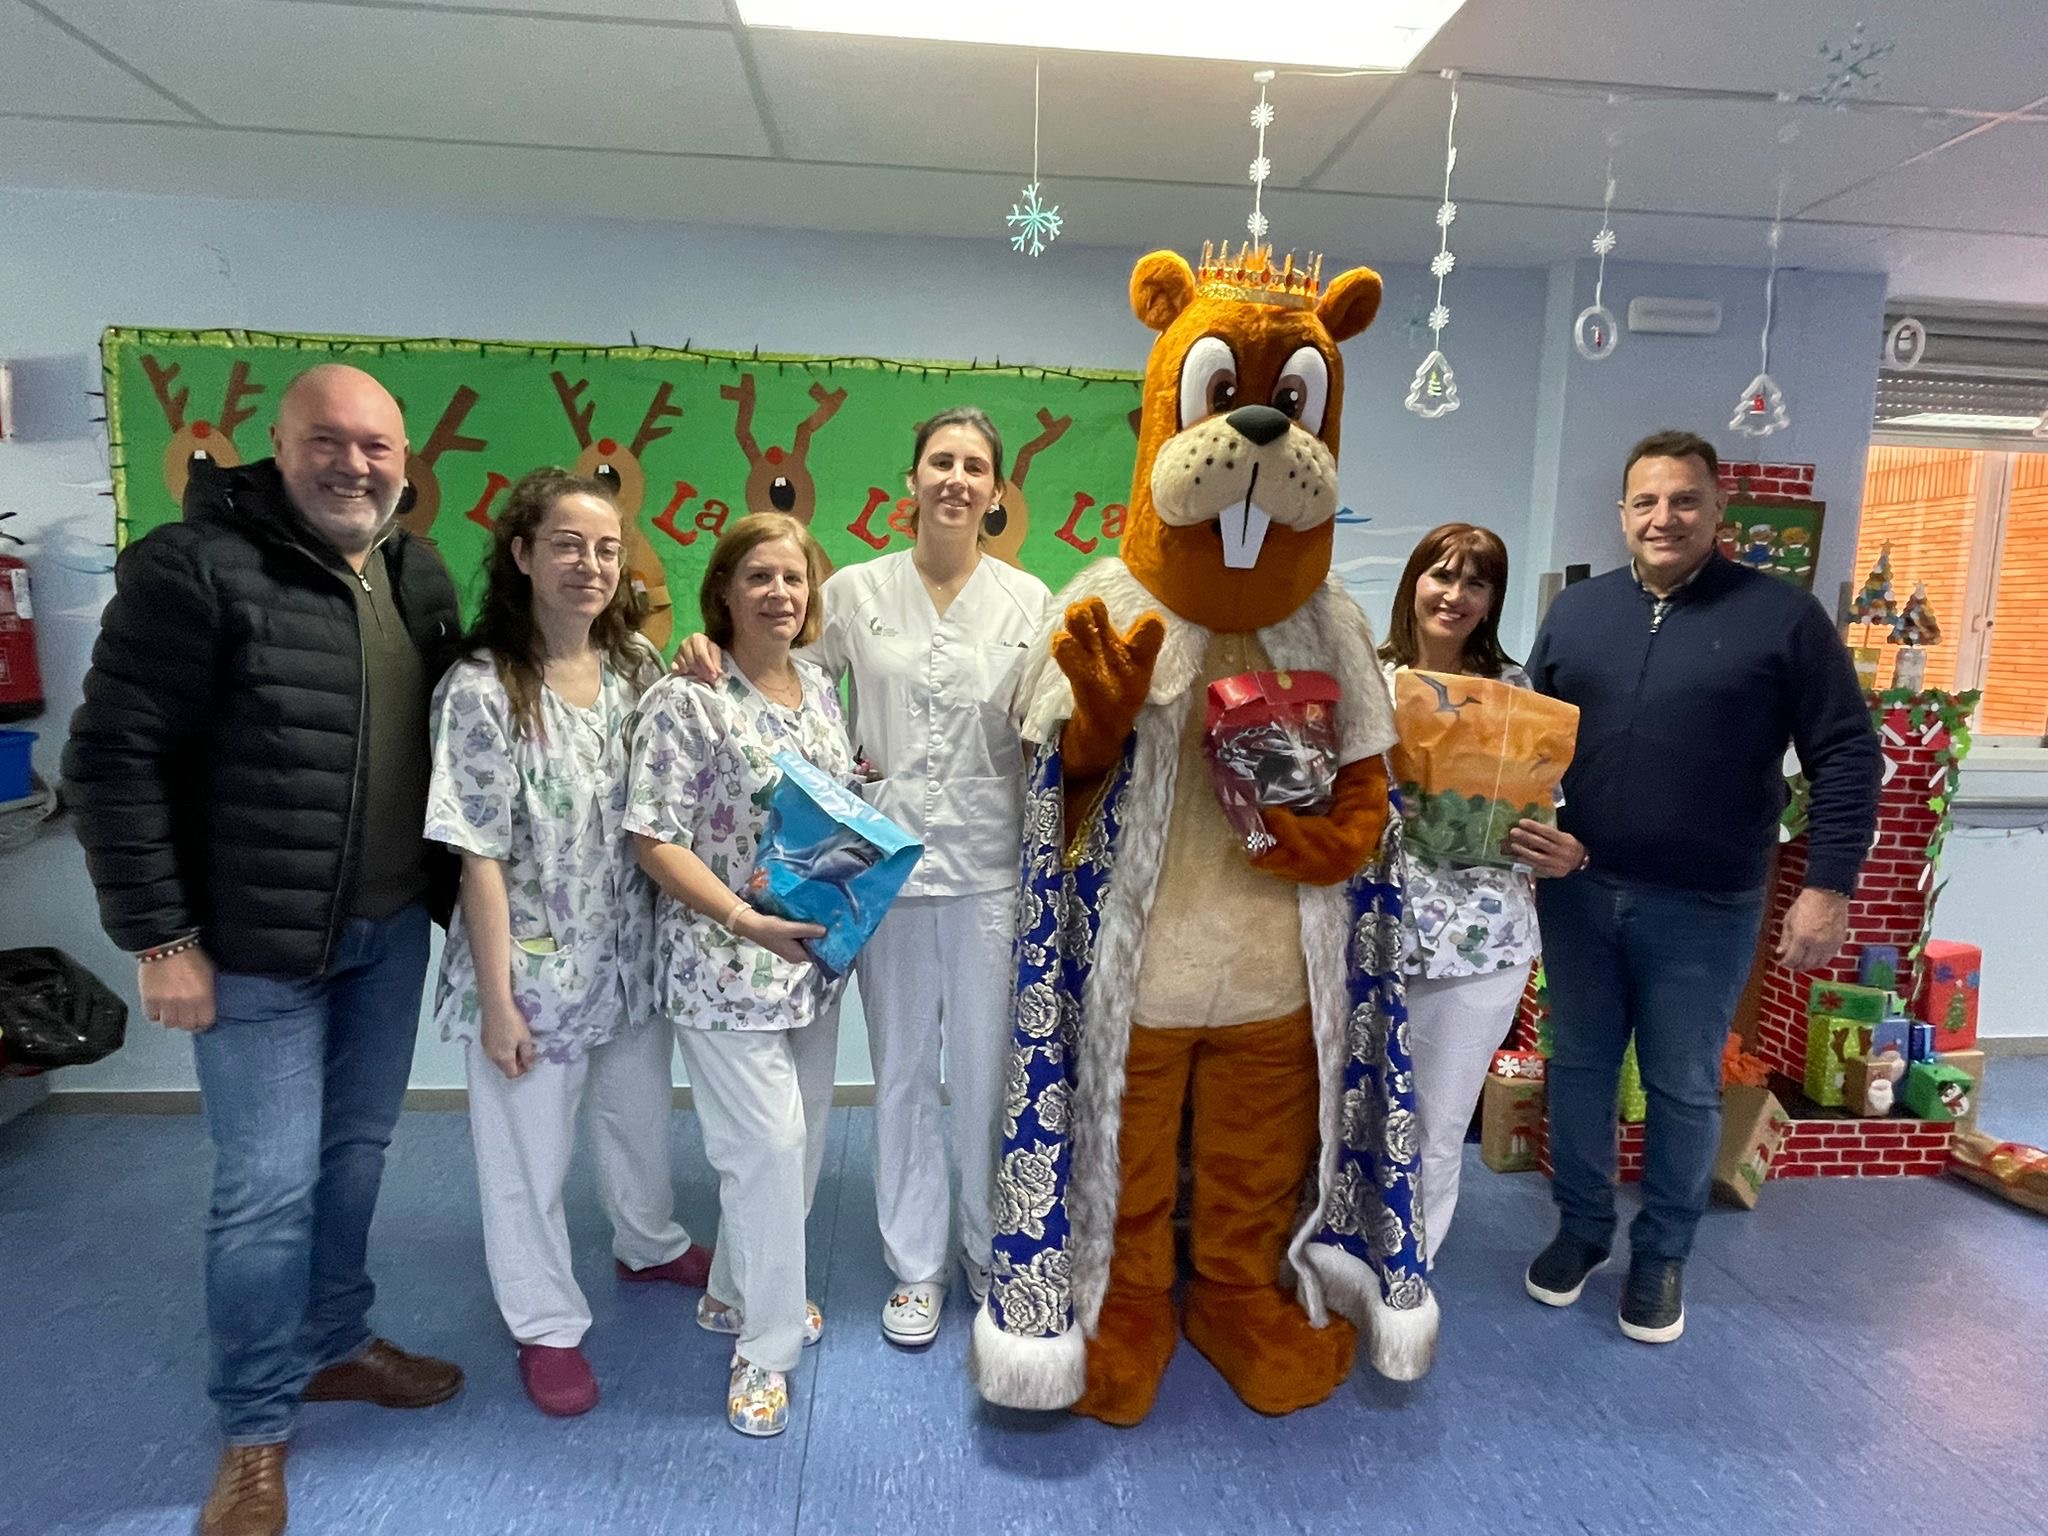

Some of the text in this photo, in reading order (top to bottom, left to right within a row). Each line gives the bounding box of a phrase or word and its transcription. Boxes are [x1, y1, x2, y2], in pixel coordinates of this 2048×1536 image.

[464, 471, 1128, 554] L La La La
